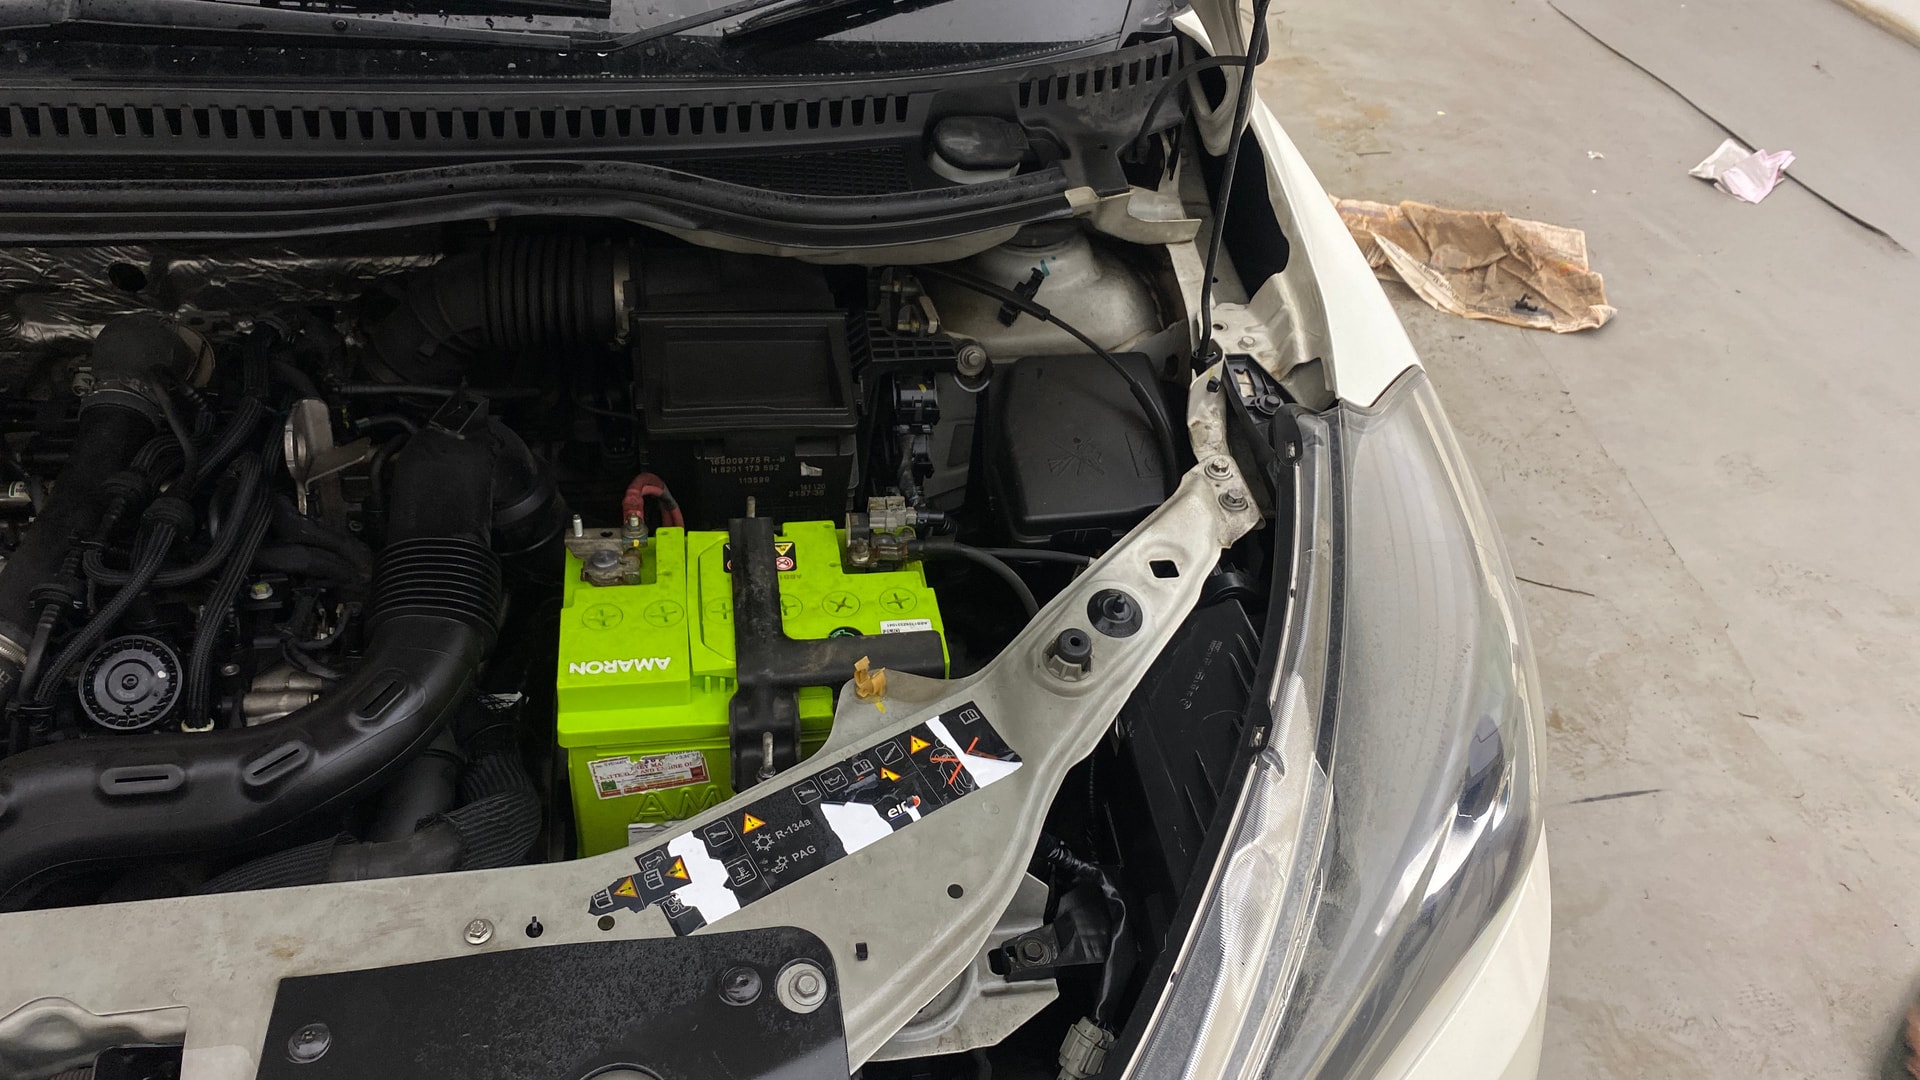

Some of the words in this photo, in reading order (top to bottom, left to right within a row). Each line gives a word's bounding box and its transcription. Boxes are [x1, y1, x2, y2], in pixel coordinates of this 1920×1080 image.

[569, 657, 671, 675] AMARON
[775, 818, 812, 840] R-134a
[791, 845, 817, 862] PAG
